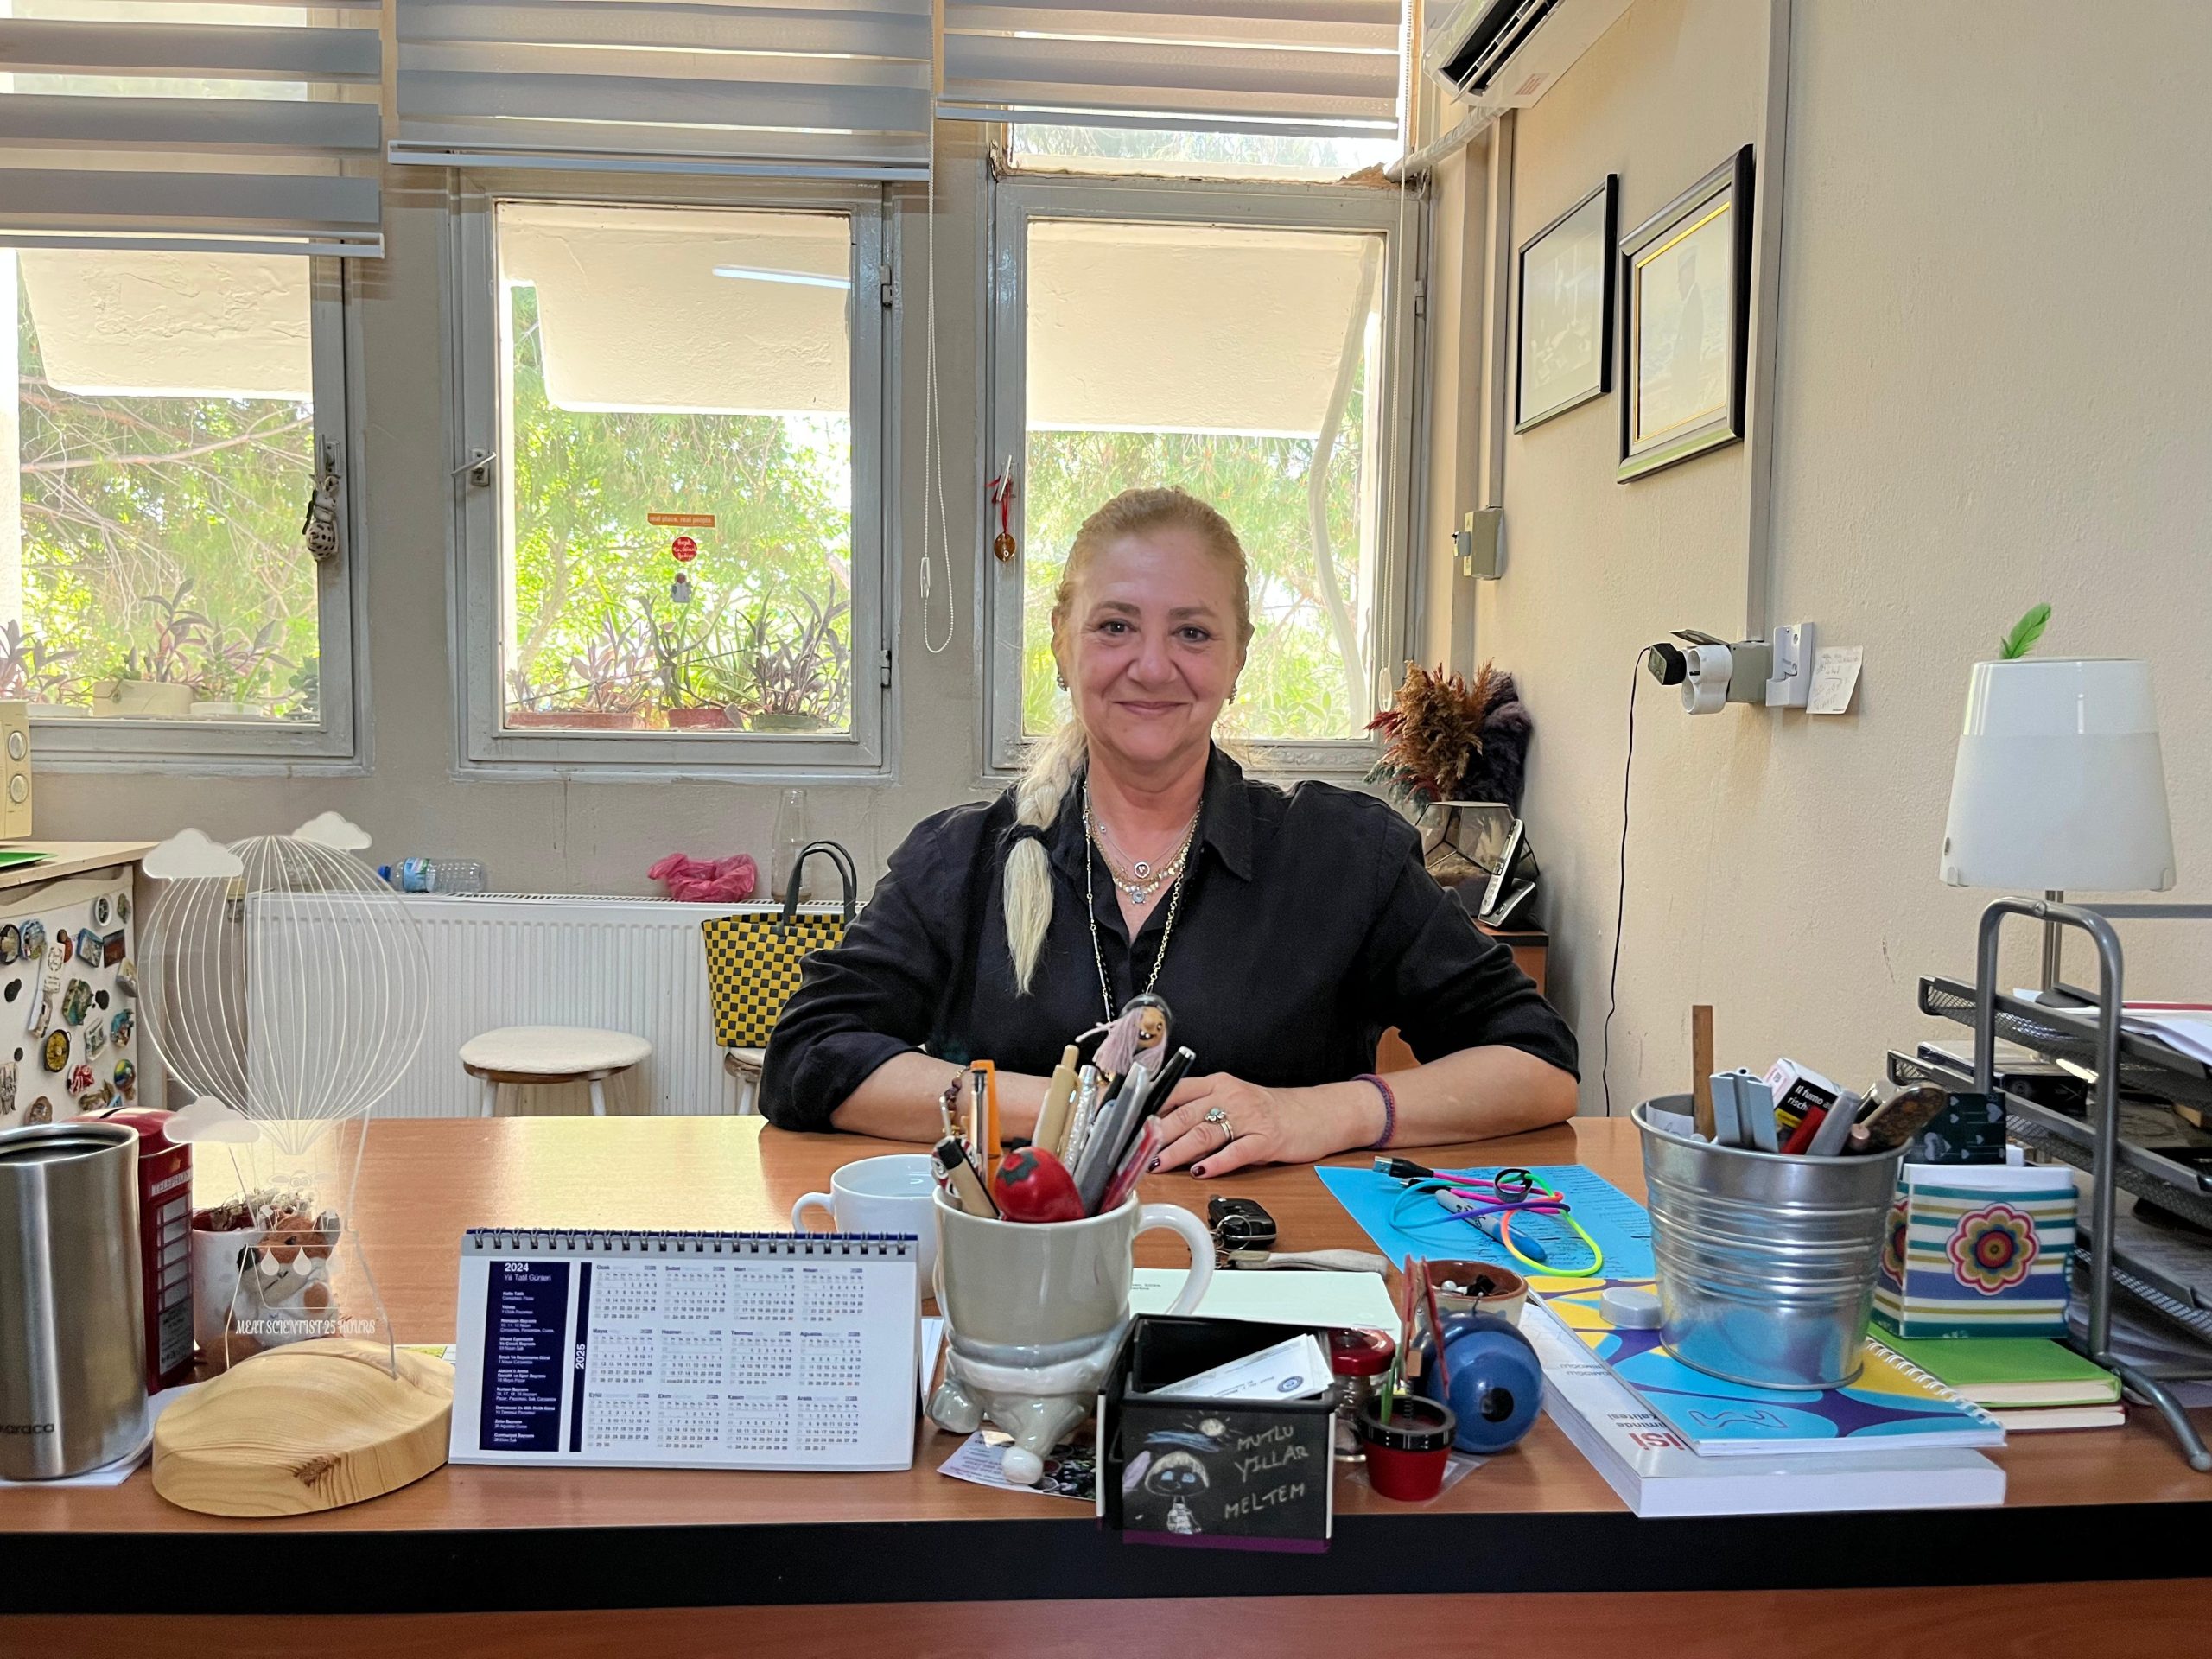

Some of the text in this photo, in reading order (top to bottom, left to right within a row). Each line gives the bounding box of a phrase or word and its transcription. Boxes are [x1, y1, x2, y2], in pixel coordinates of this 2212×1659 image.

[1788, 1097, 1808, 1111] risch
[1795, 1085, 1804, 1094] Il
[1802, 1089, 1823, 1104] fumo
[154, 1170, 190, 1193] TELEPHON
[504, 1262, 529, 1272] 2024
[236, 1319, 375, 1334] MEAT SCIENTIST 25 HOURS
[575, 1344, 586, 1369] 2025
[1237, 1426, 1294, 1451] MUTLU
[1235, 1446, 1309, 1483] YILLAR
[1224, 1482, 1306, 1519] MELTEM
